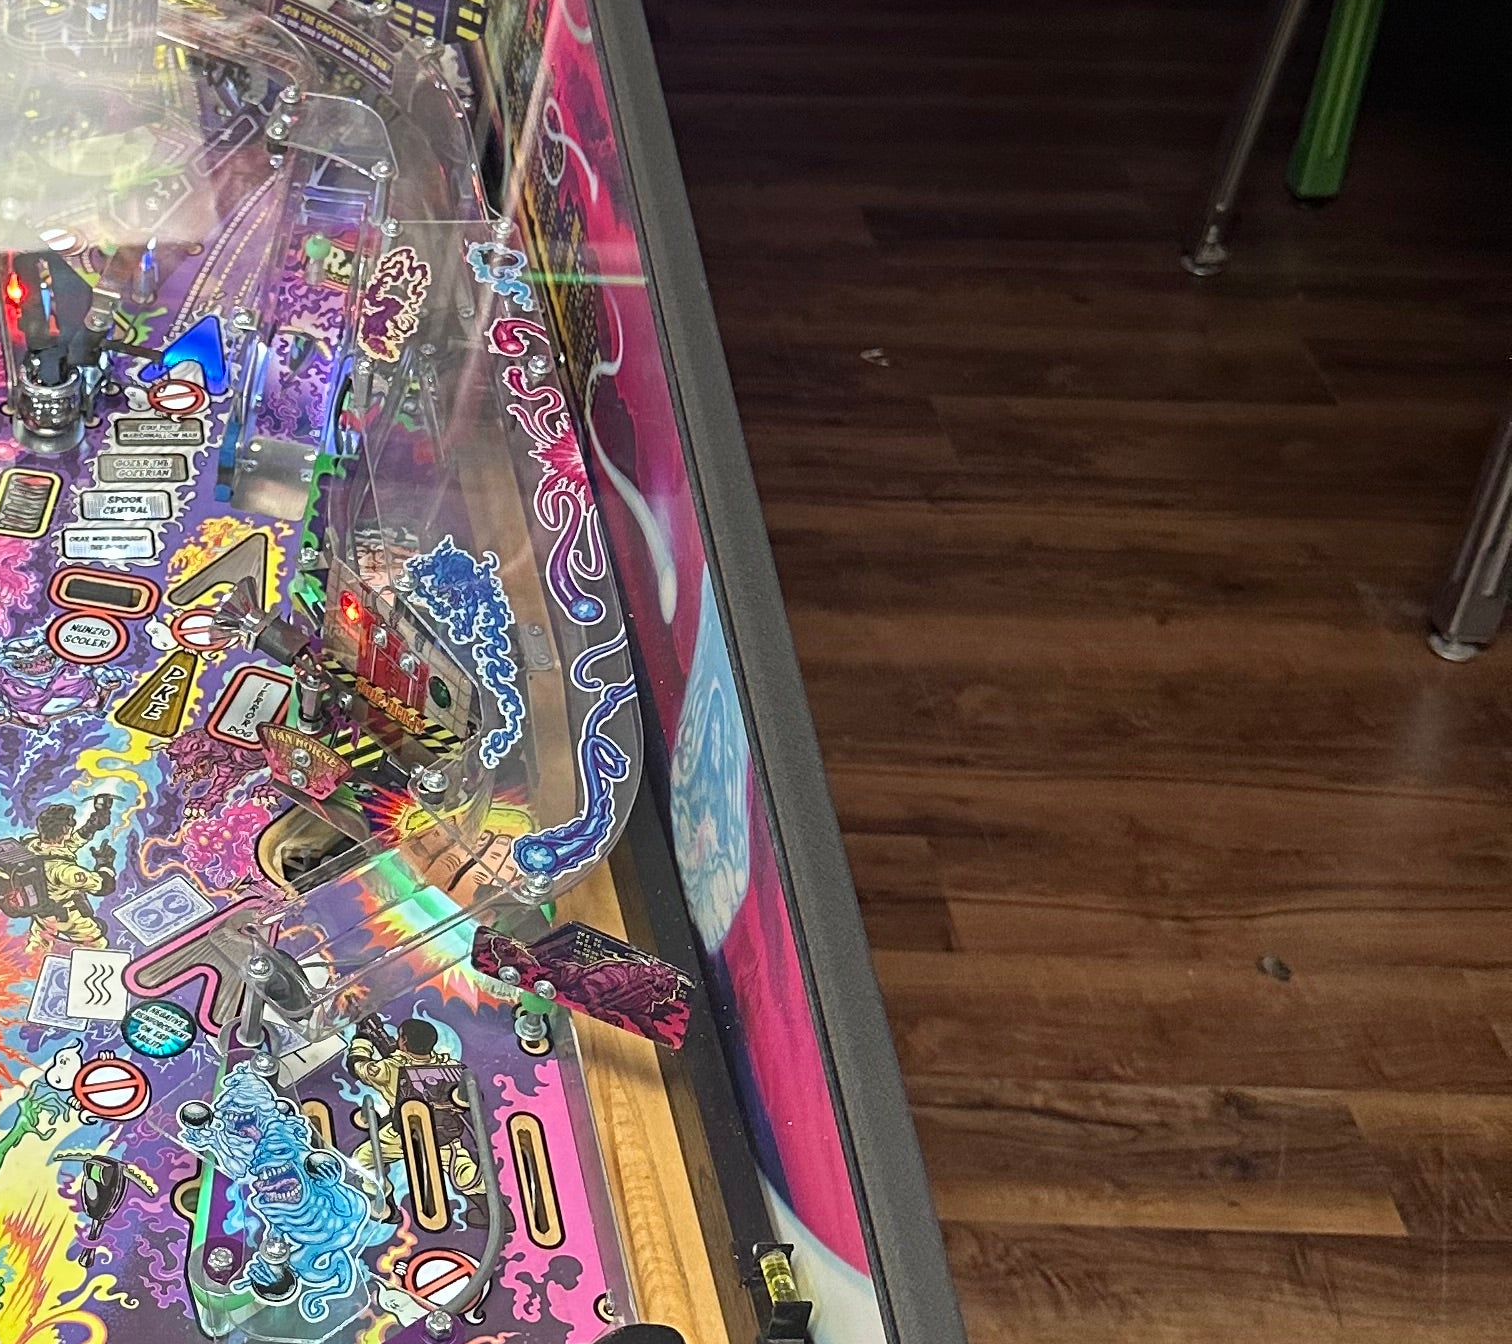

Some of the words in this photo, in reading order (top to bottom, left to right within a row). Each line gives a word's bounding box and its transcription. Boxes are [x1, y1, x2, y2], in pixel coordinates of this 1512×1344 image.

[107, 495, 143, 504] SPOOK
[69, 623, 111, 637] NUNZIO
[63, 634, 111, 649] SCOLERI
[141, 664, 187, 721] PKE
[268, 728, 295, 746] VAN
